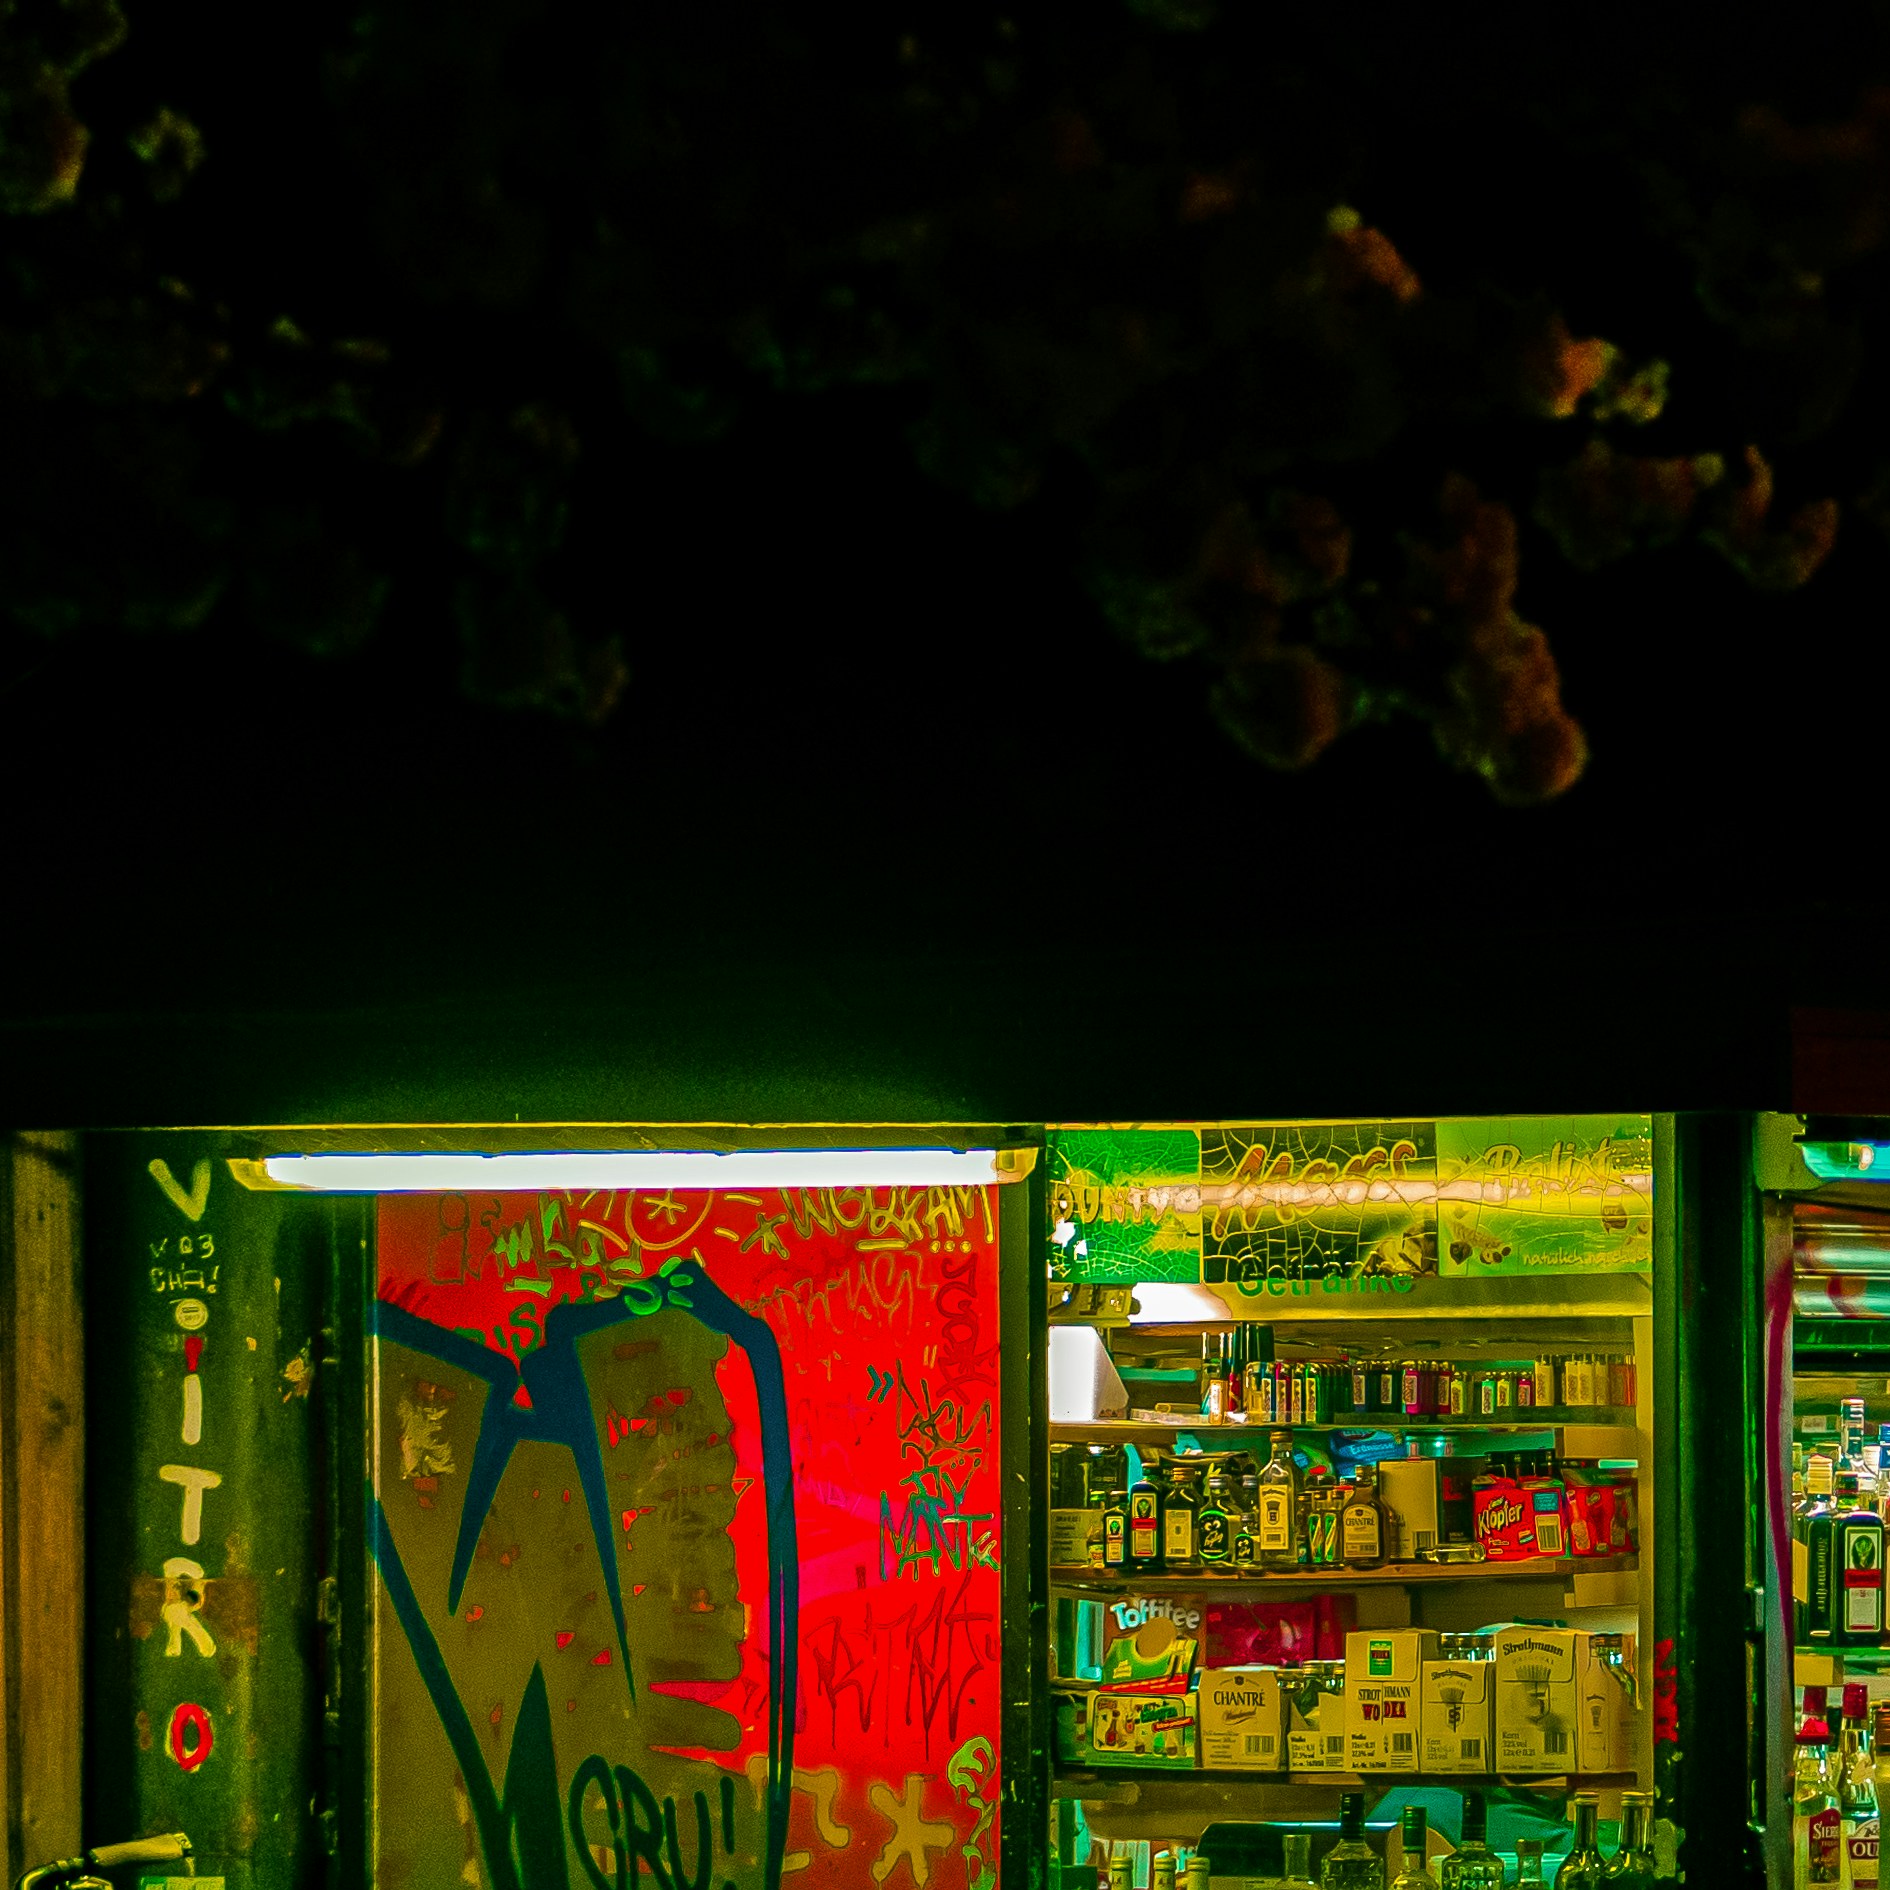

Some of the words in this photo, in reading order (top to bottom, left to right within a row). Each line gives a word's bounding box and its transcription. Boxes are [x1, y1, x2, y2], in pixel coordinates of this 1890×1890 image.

[1110, 1597, 1200, 1630] Toffifee
[1213, 1687, 1266, 1707] CHANTRÉ
[1852, 1840, 1880, 1857] OU
